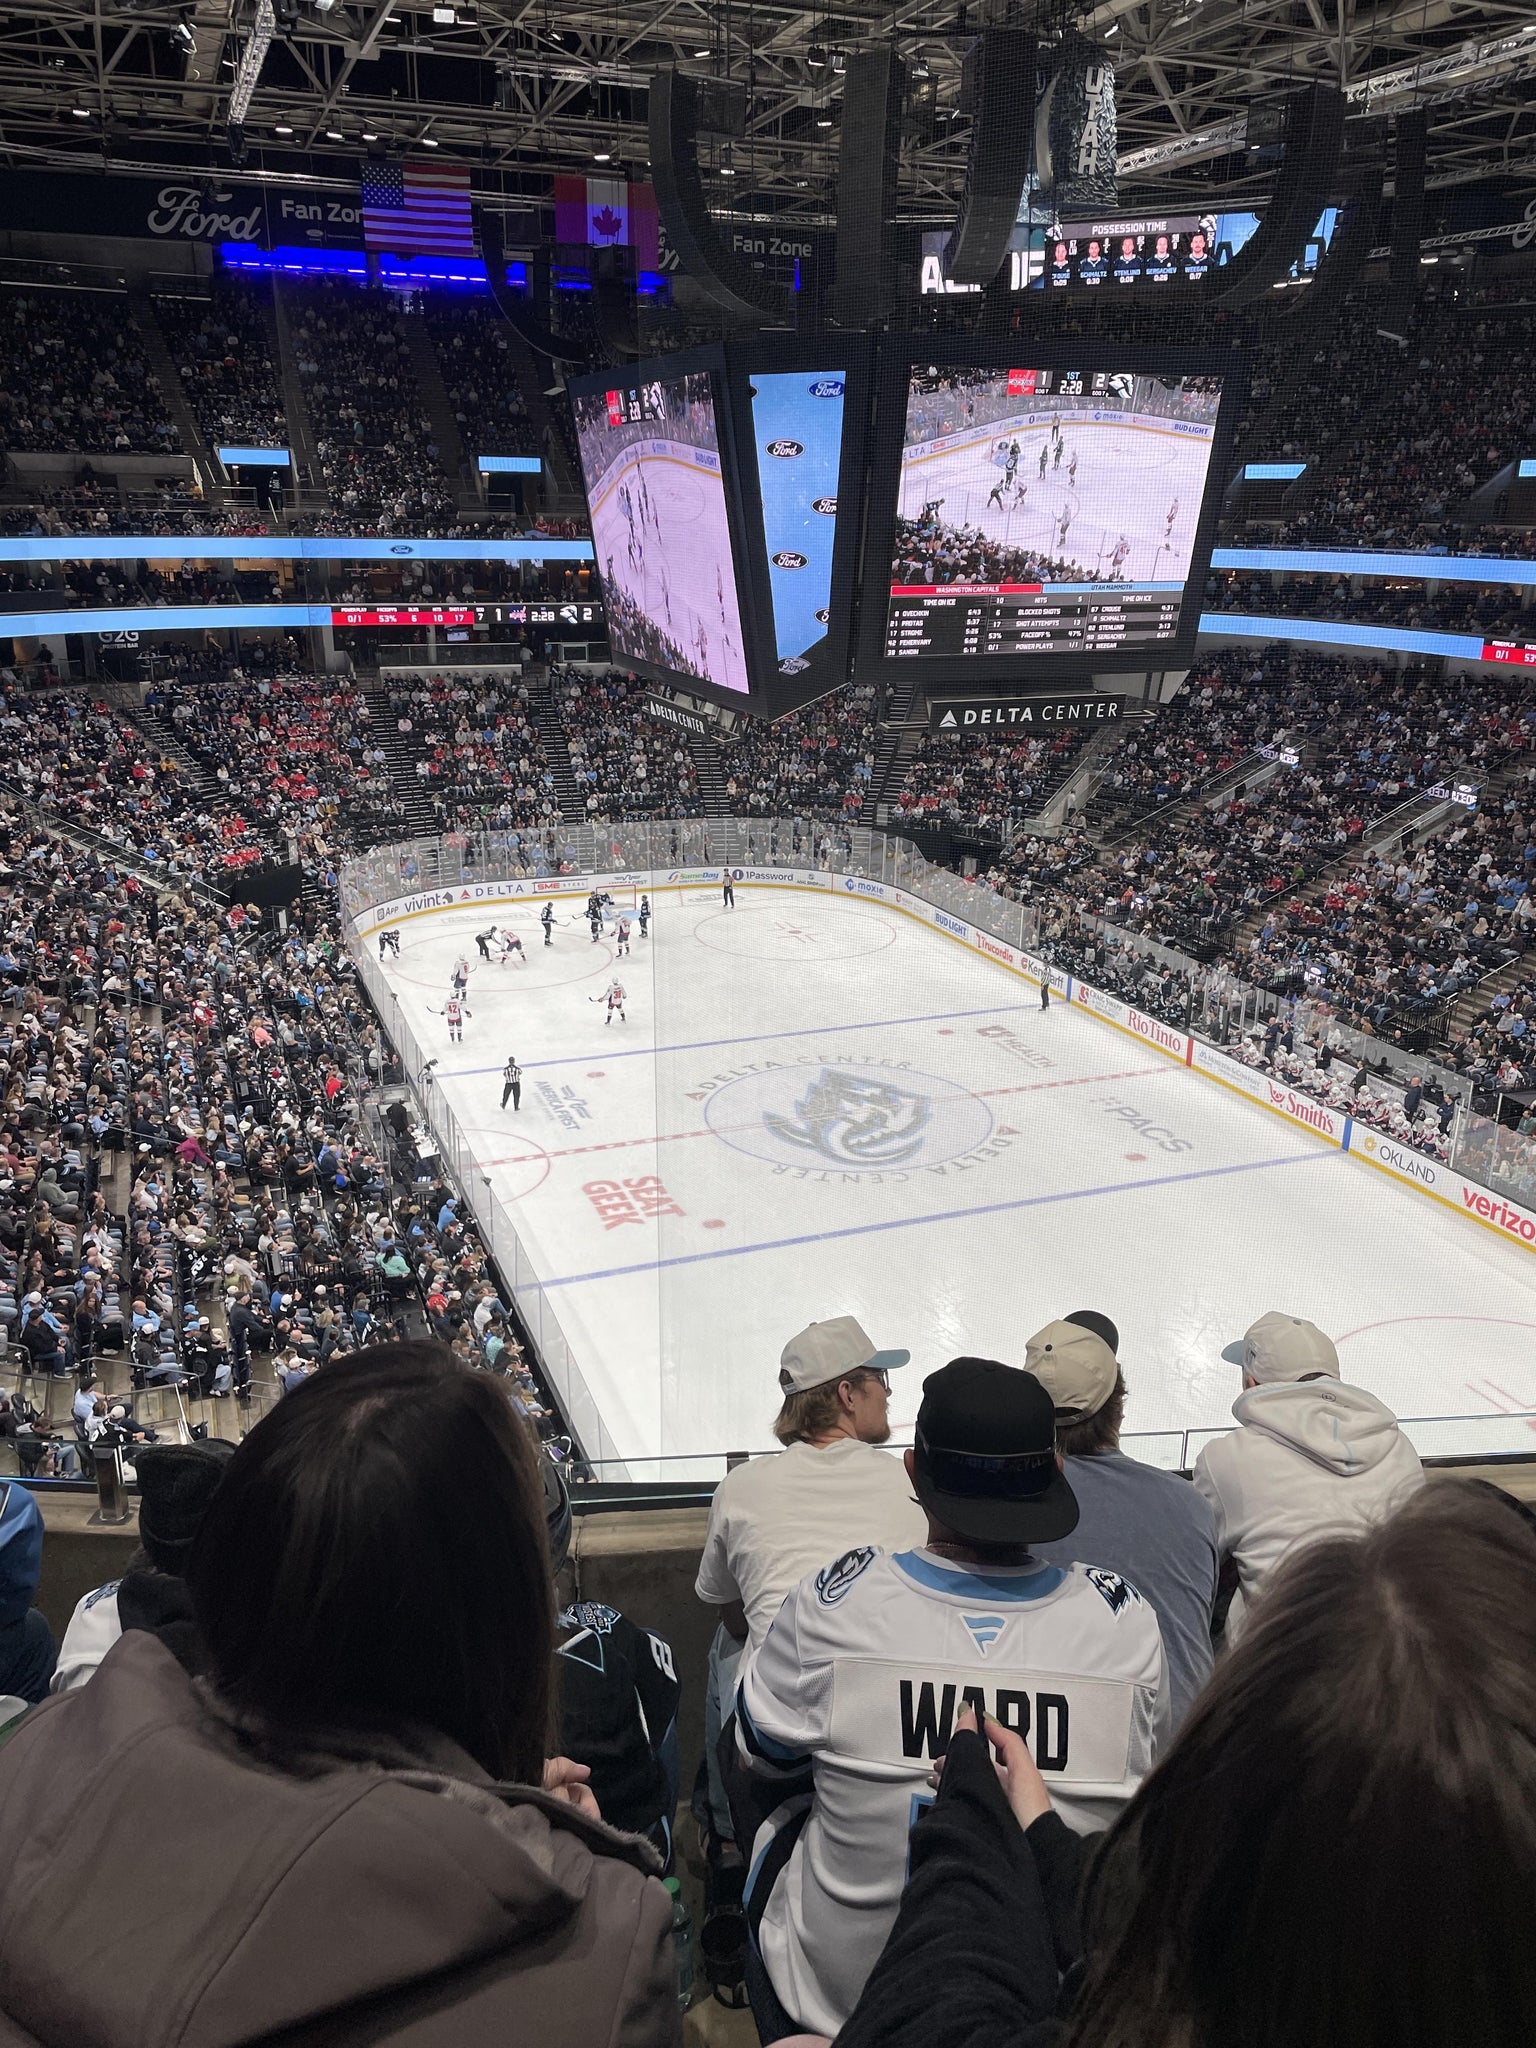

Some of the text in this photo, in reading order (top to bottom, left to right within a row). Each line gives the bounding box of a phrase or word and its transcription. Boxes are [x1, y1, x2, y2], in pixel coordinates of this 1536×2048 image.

[1078, 66, 1105, 175] UTAH
[147, 186, 262, 240] Ford
[281, 200, 322, 220] Fan
[1092, 221, 1167, 235] POSSESSION TIME
[733, 235, 812, 257] Fan Zone
[1041, 371, 1047, 386] 1
[1066, 371, 1080, 380] 1ST
[1096, 373, 1105, 388] 2
[815, 381, 841, 396] Ford
[1060, 380, 1083, 394] 2:28
[772, 442, 798, 456] Ford
[818, 499, 837, 512] For
[777, 553, 801, 567] Ford
[936, 585, 999, 594] WASHINGTON CAPITALS
[347, 615, 362, 623] 0/1
[379, 615, 397, 623] 53%
[478, 613, 483, 621] 7
[496, 608, 501, 621] 1
[531, 612, 555, 621] 2:28
[583, 607, 592, 621] 2
[1496, 650, 1508, 659] 0/1
[1524, 653, 1536, 663] 53
[655, 703, 705, 734] DELTA CENTER
[963, 702, 1118, 725] DELTA CENTER
[746, 871, 794, 882] 1Password
[476, 884, 524, 896] DELTA
[857, 881, 884, 895] moxie
[935, 913, 967, 937] BUD LIGHT
[981, 936, 1014, 963] Trucordia
[448, 1005, 457, 1013] 42
[1002, 1038, 1058, 1068] HEALTH
[699, 1055, 912, 1091] DELTA CENTER
[534, 1080, 567, 1114] AMERICA
[556, 1106, 581, 1130] FIRST
[1286, 1092, 1334, 1134] Smith's
[1104, 1106, 1193, 1152] PACS
[771, 1137, 1013, 1184] DELTA CENTER
[1379, 1145, 1436, 1184] OKLAND
[622, 1175, 687, 1217] SEAT
[582, 1180, 645, 1231] GEEK
[1463, 1186, 1536, 1244] verizo
